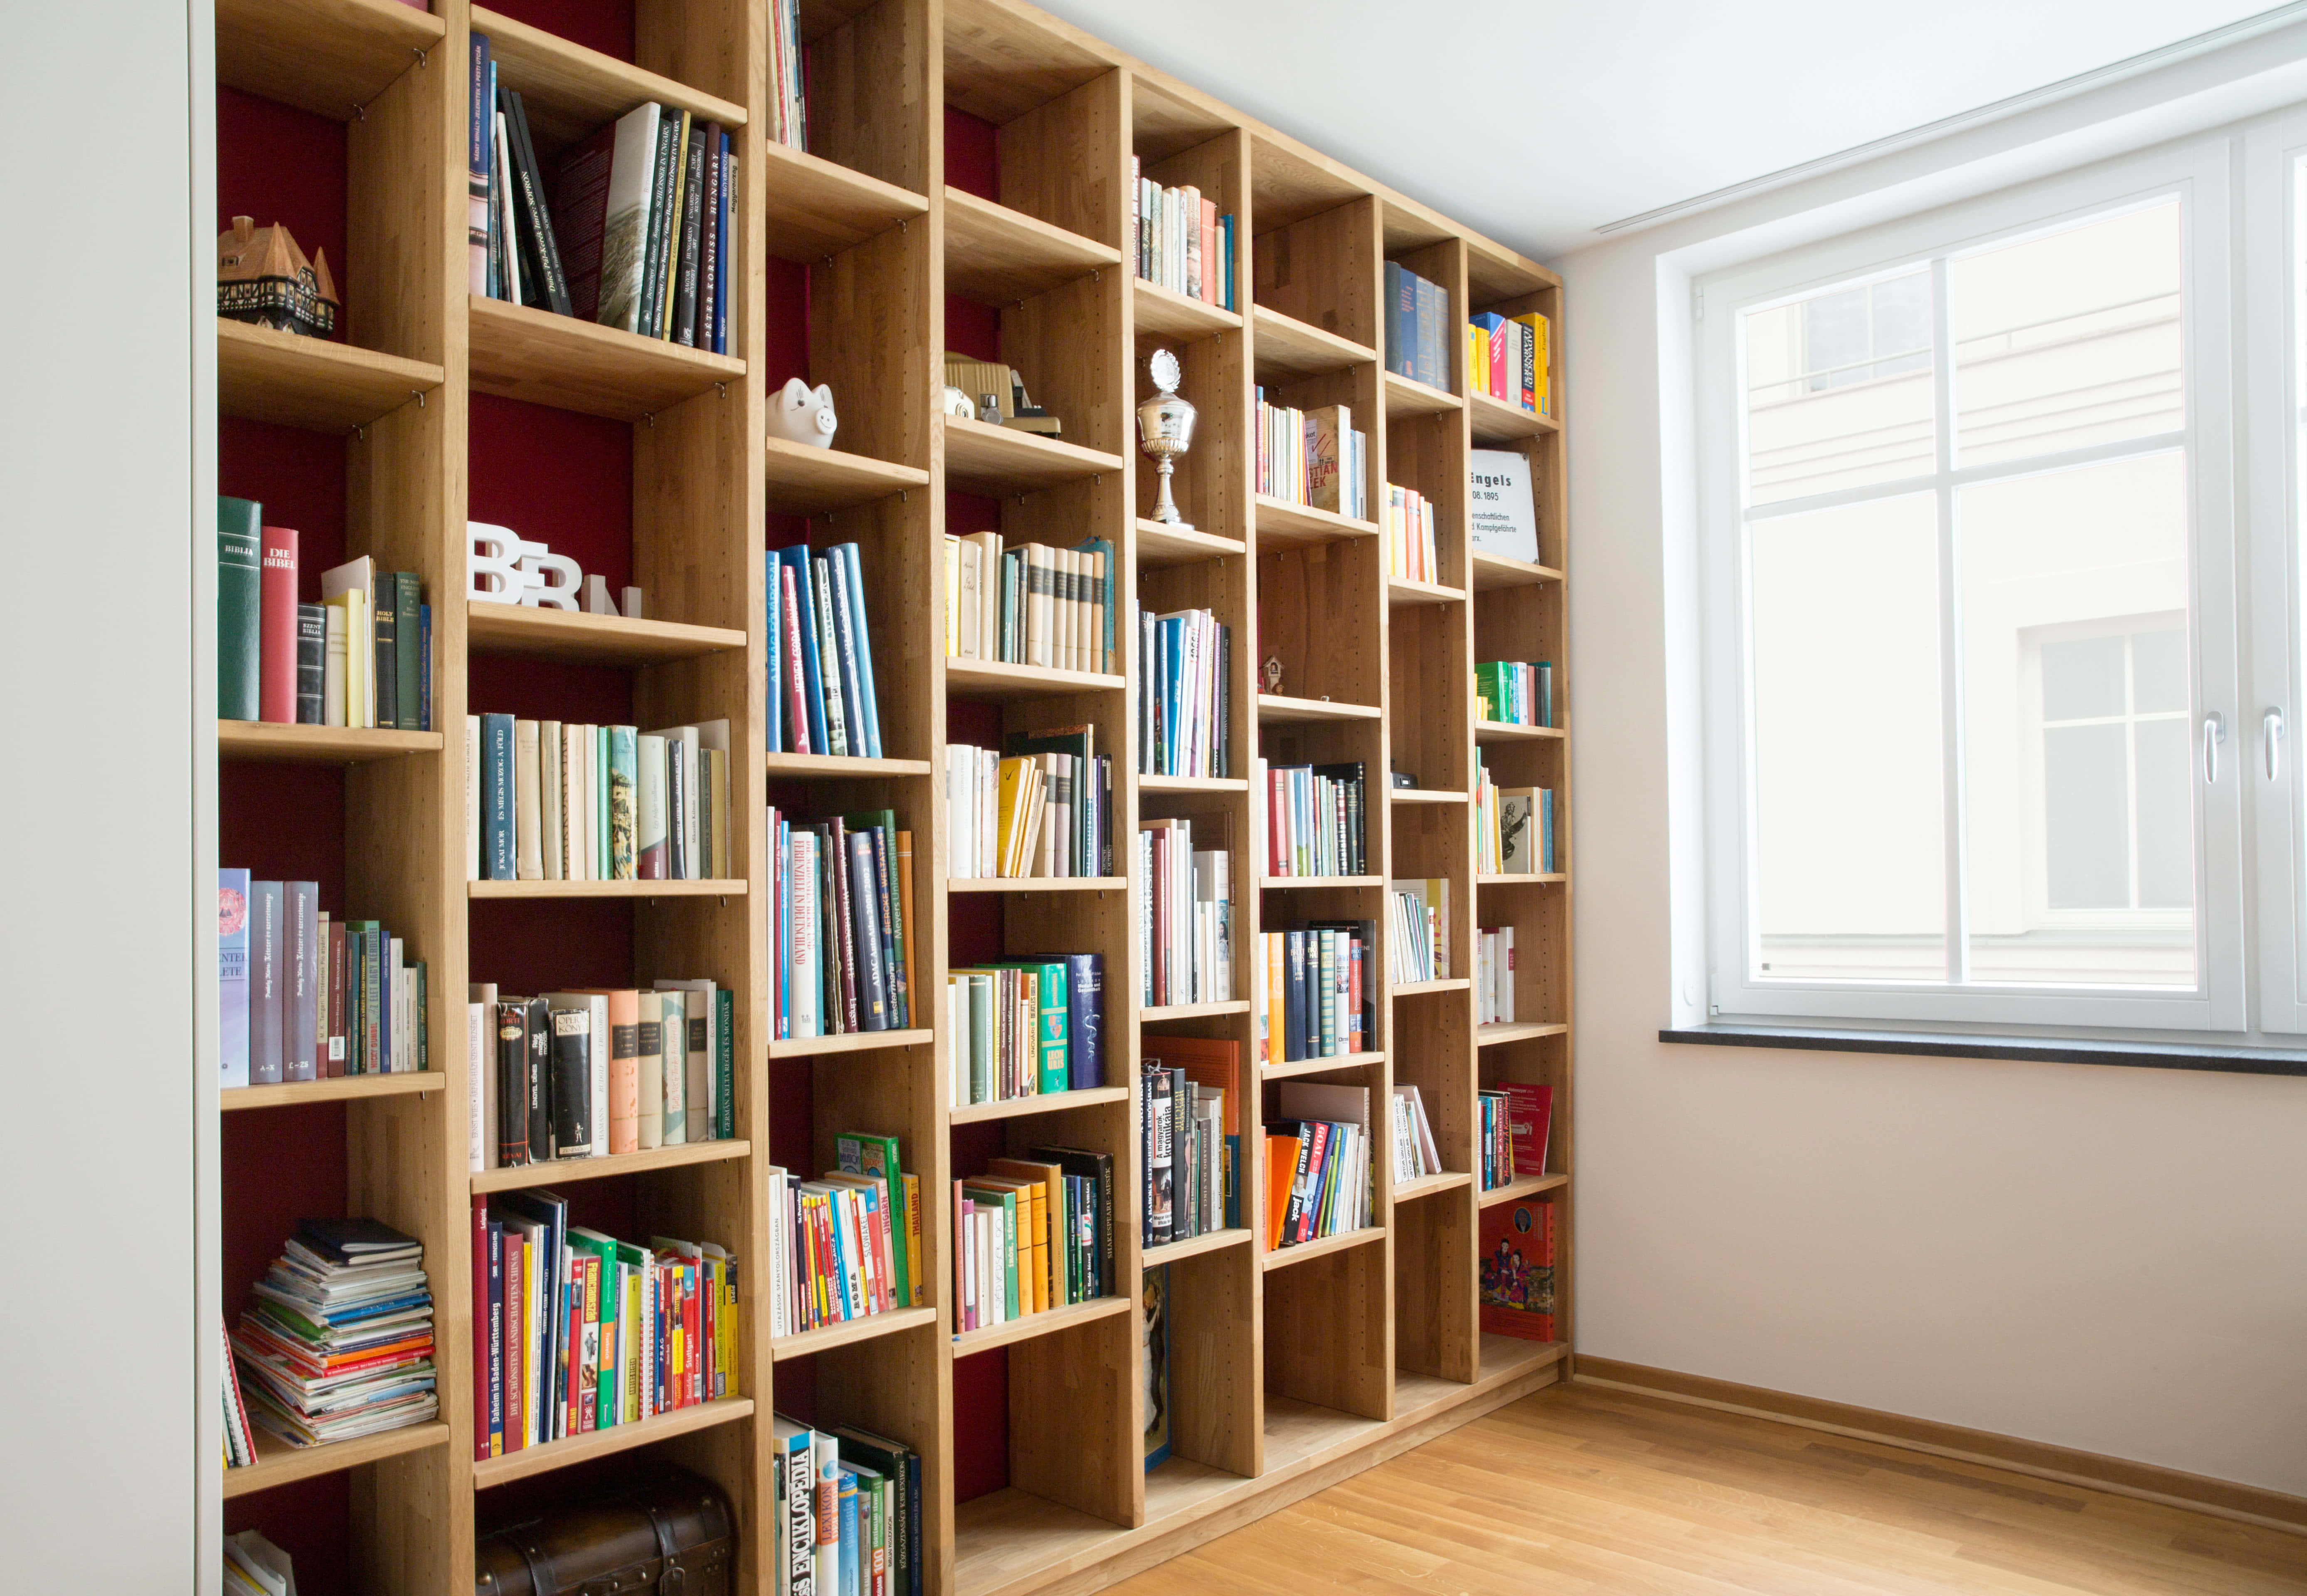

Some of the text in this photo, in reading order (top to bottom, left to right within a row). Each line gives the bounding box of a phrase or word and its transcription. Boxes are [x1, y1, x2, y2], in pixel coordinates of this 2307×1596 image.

[522, 170, 535, 205] SOPRON
[655, 166, 665, 208] SCHLÖSSER
[660, 125, 670, 155] UNGARN
[541, 204, 550, 229] SOPRON
[705, 153, 719, 338] PÉTER KORNISS HUNGARY
[225, 545, 254, 556] BIBLIA
[264, 557, 296, 569] BIBEL
[270, 548, 290, 559] DIE
[794, 840, 804, 894] FERIENZIELE
[877, 833, 891, 935] DIERCKE WELTATLAS
[887, 828, 899, 901] Universalatlas
[794, 905, 804, 965] DEUTSCHLAND
[863, 867, 880, 987] ADAC 2001/2002
[887, 963, 899, 1024] westermann
[1047, 1049, 1064, 1059] LEON
[1047, 1059, 1064, 1071] URIS
[1163, 1106, 1171, 1158] krónikája
[1299, 1128, 1311, 1173] JACK WELCH
[1314, 1126, 1325, 1158] GOAL
[881, 1196, 890, 1235] UNGARN
[911, 1193, 920, 1237] THAILAND
[1291, 1197, 1302, 1221] jack
[860, 1216, 871, 1258] SLOWAKEI
[491, 1303, 501, 1383] Baden-Württemberg
[509, 1352, 518, 1400] SCHÖNSTEN
[789, 1449, 811, 1577] ENCIKLOPÉDIA
[821, 1486, 832, 1541] LEXIKON
[874, 1549, 884, 1574] 100
